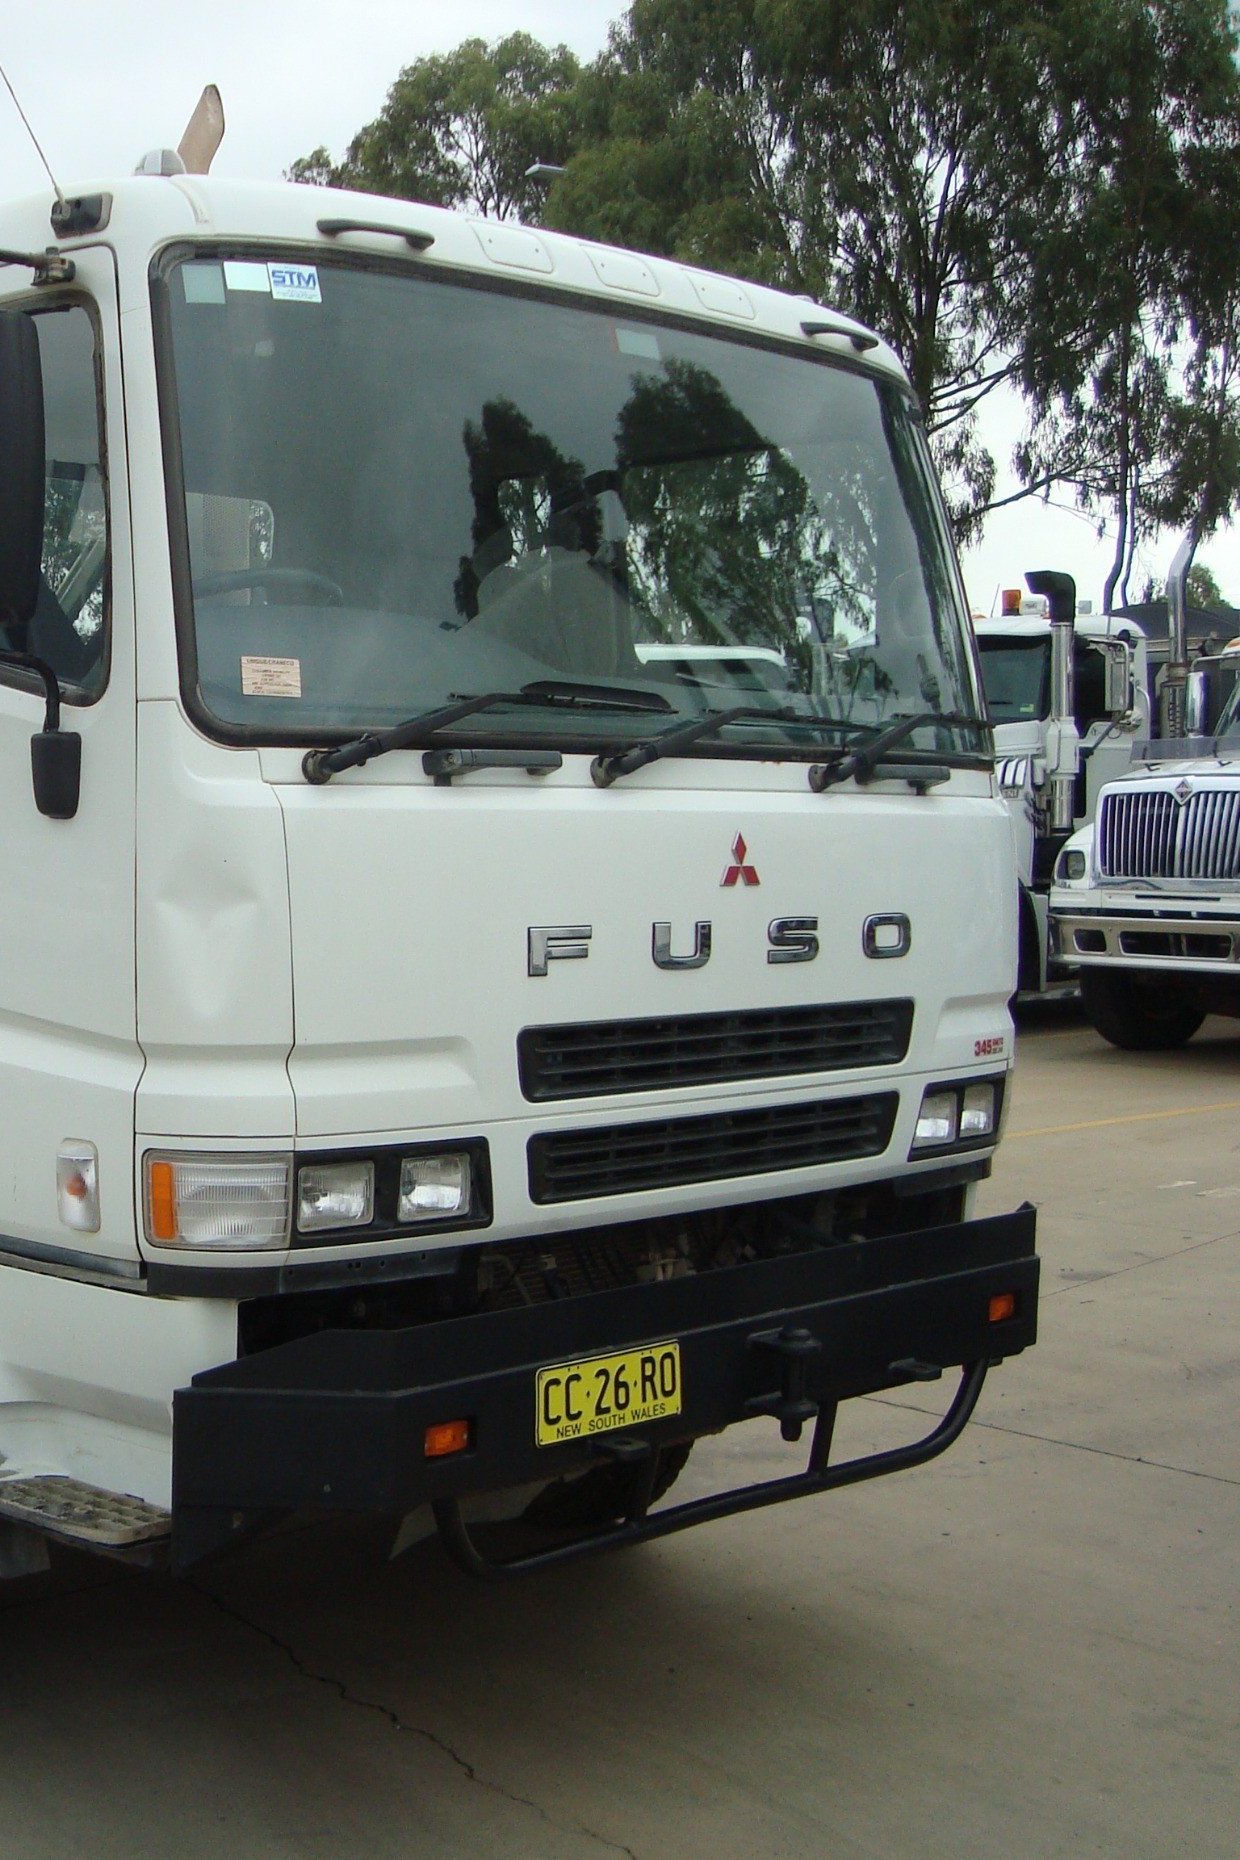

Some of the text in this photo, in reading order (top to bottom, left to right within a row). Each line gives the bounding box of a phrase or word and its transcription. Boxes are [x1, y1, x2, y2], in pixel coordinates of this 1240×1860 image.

[271, 269, 316, 289] STM
[526, 912, 912, 978] FUSO
[974, 1039, 992, 1056] 345
[556, 1402, 666, 1440] NEW SOUTH WALES
